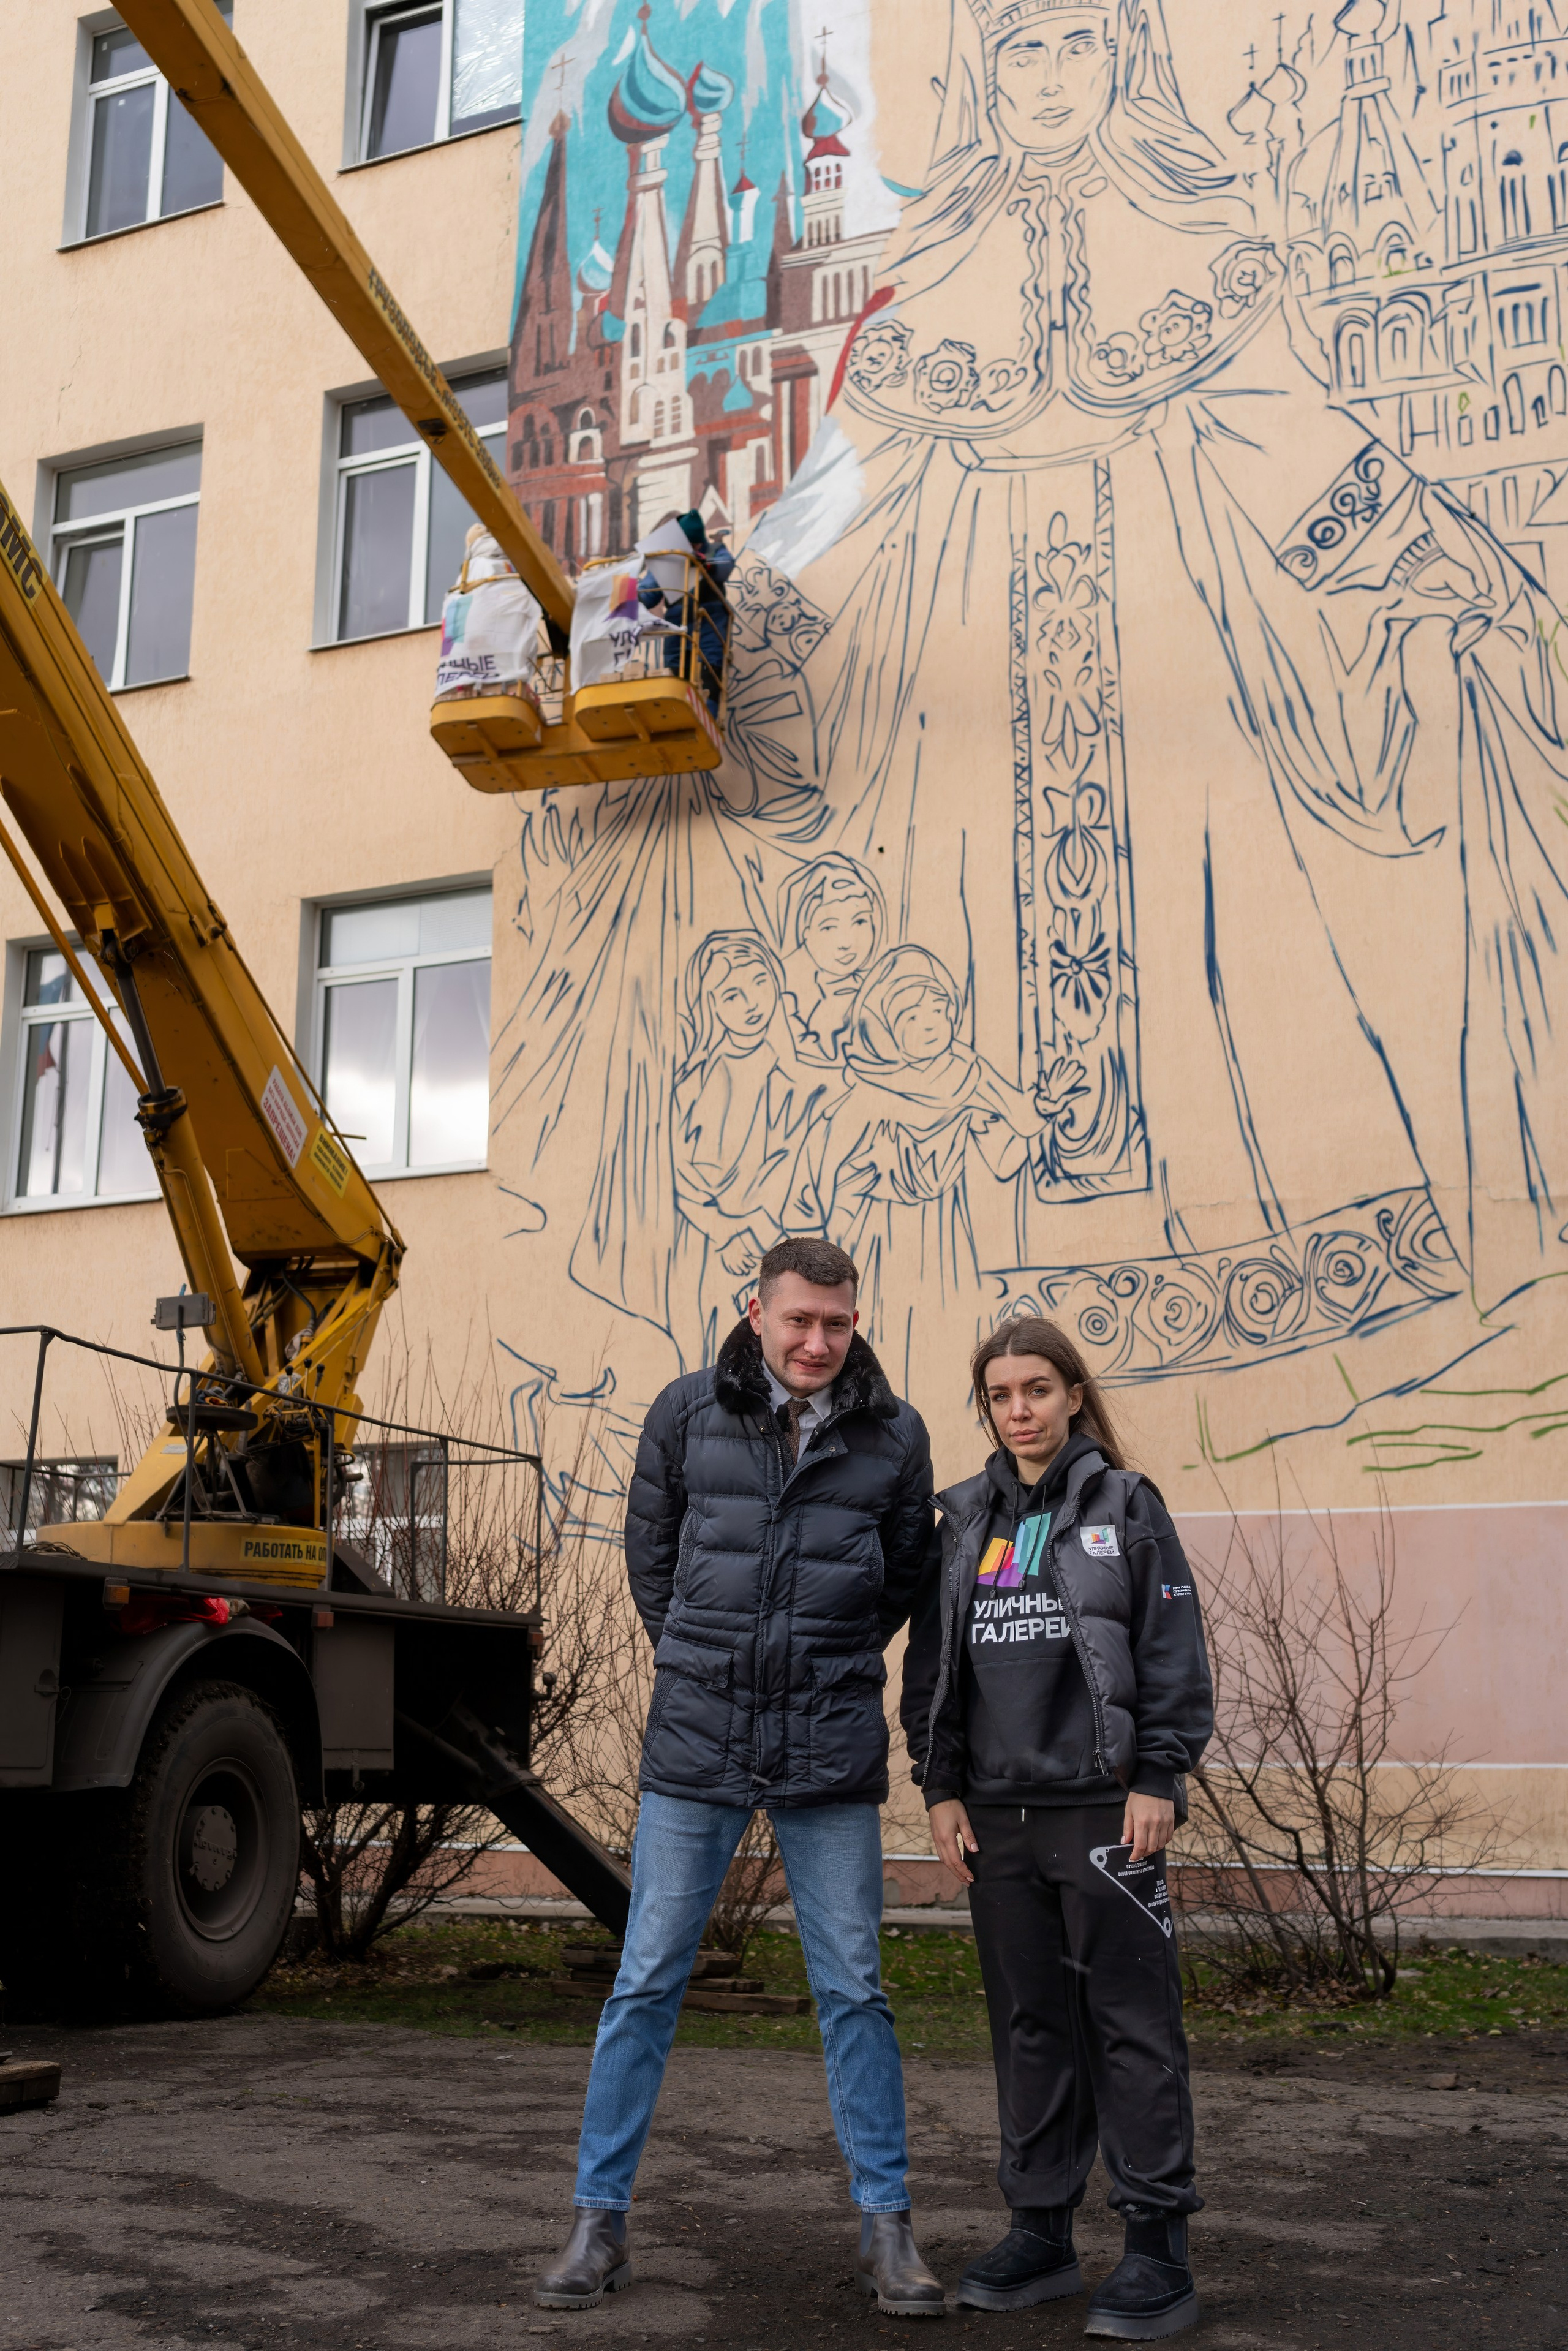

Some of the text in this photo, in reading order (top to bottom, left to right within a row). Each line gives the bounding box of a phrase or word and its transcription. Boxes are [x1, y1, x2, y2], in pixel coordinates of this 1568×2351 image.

[263, 1097, 296, 1163] ЗАПРЕЩЕНА!
[319, 1134, 348, 1176] ВНИМАНИЕ!
[244, 1541, 303, 1559] РАБОТАТЬ
[306, 1545, 317, 1560] НА
[974, 1593, 1064, 1618] УЛИЧНЫ
[972, 1616, 1071, 1644] ГАЛЕРЕИ
